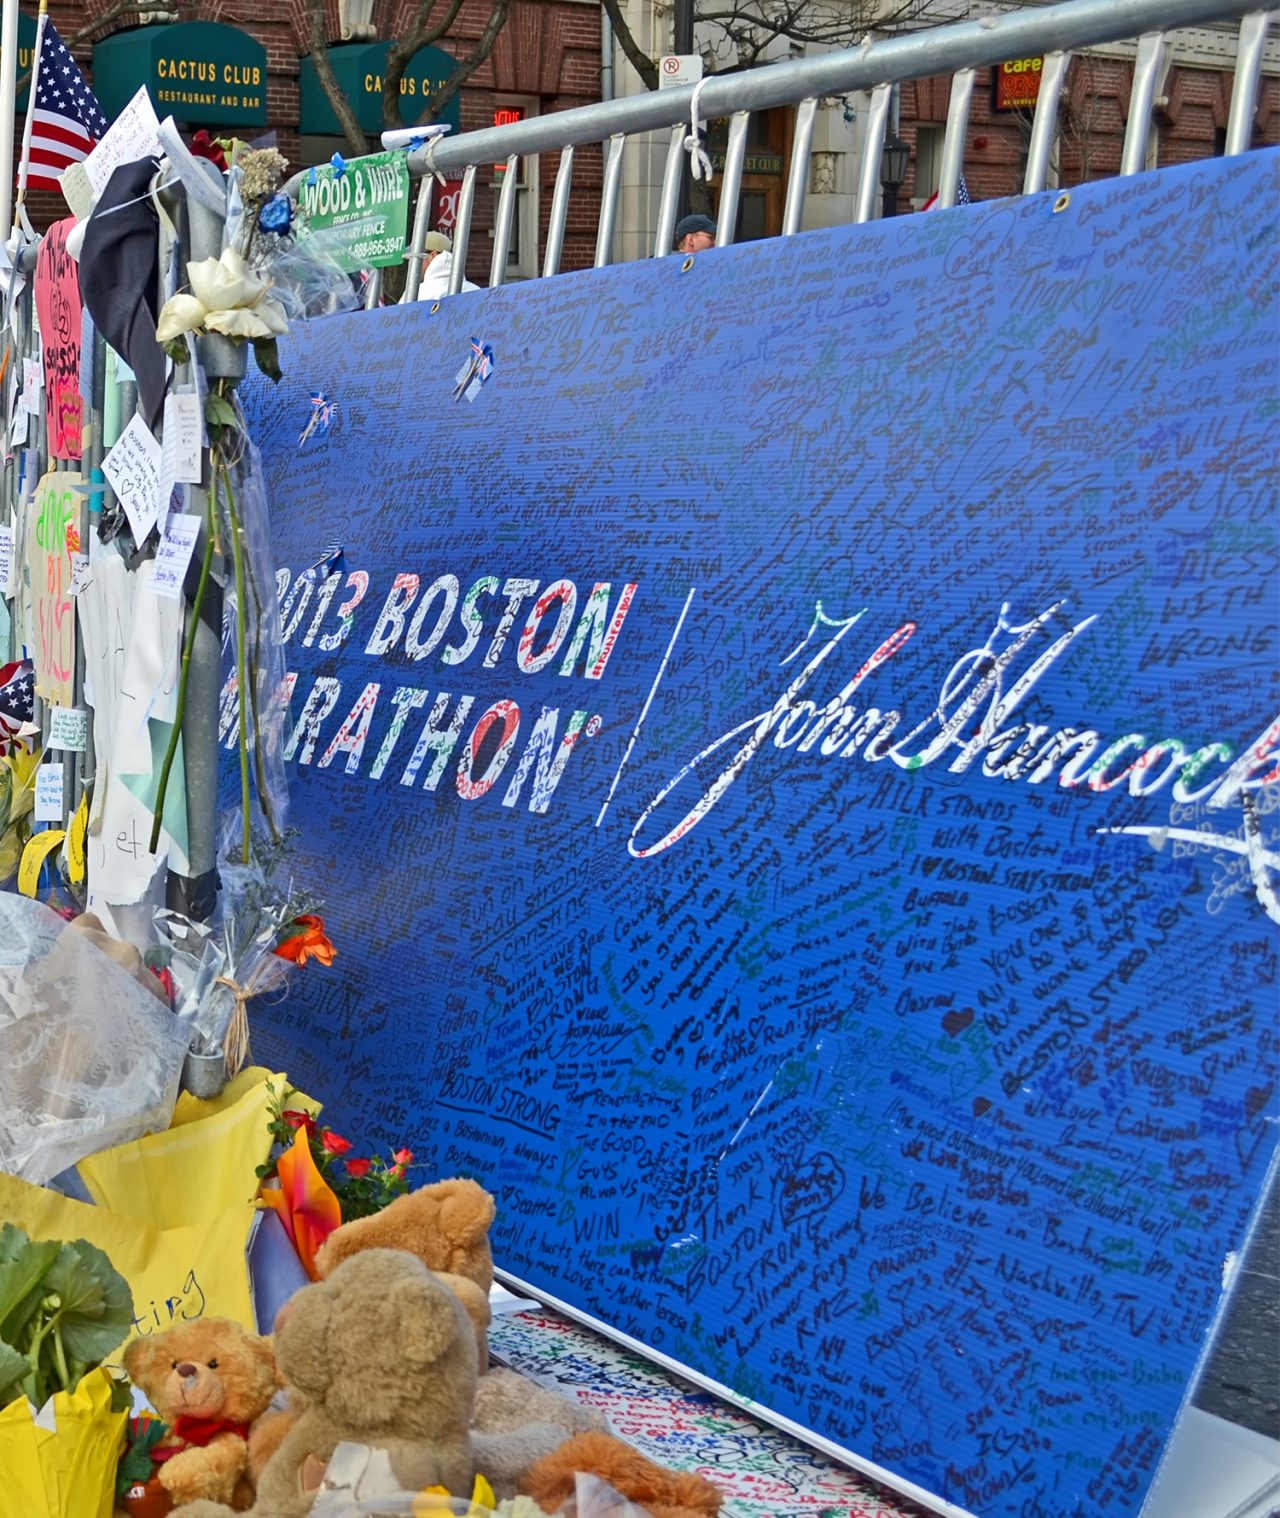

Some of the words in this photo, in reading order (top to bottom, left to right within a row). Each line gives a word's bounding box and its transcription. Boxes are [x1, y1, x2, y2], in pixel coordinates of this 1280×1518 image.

[158, 58, 217, 82] CACTUS
[223, 64, 261, 86] CLUB
[365, 74, 415, 95] CAUS
[1003, 57, 1042, 74] cafe
[158, 90, 217, 105] RESTAURANT
[221, 97, 239, 107] AND
[242, 98, 260, 108] BAR
[304, 174, 351, 216] WOOD
[355, 169, 366, 209] &
[369, 161, 404, 206] WIRE
[1076, 175, 1162, 227] Battered
[362, 223, 385, 237] FENCE
[1103, 208, 1183, 268] broken
[1010, 261, 1086, 316] Thank
[1160, 580, 1266, 623] WITH
[364, 572, 637, 680] BOSTON
[1137, 624, 1278, 671] WRONG
[629, 605, 915, 857] John
[937, 794, 1017, 821] STANDS
[983, 825, 1060, 859] Boston
[471, 906, 517, 949] Stay
[615, 888, 673, 943] Courage
[651, 915, 698, 958] going
[628, 931, 651, 953] the
[502, 975, 546, 1014] ALOHA
[505, 967, 538, 997] WITH
[439, 1071, 498, 1107] BOSTON
[495, 1086, 561, 1132] STRONG
[454, 1119, 507, 1153] Bostonian,
[512, 1143, 558, 1172] always
[601, 1131, 647, 1155] GOOD
[918, 1119, 947, 1143] good
[511, 1190, 557, 1218] Seattle
[579, 1178, 638, 1200] ALWAYS
[903, 1181, 993, 1229] Believe
[1005, 1225, 1027, 1241] in
[496, 1220, 520, 1247] until
[526, 1230, 537, 1246] it
[578, 1248, 606, 1272] there
[608, 1259, 630, 1278] can
[684, 1217, 780, 1304] BOSTON
[708, 1217, 839, 1309] STRONG
[655, 1290, 688, 1333] Teresa
[737, 1291, 775, 1324] will
[733, 1328, 767, 1356] but
